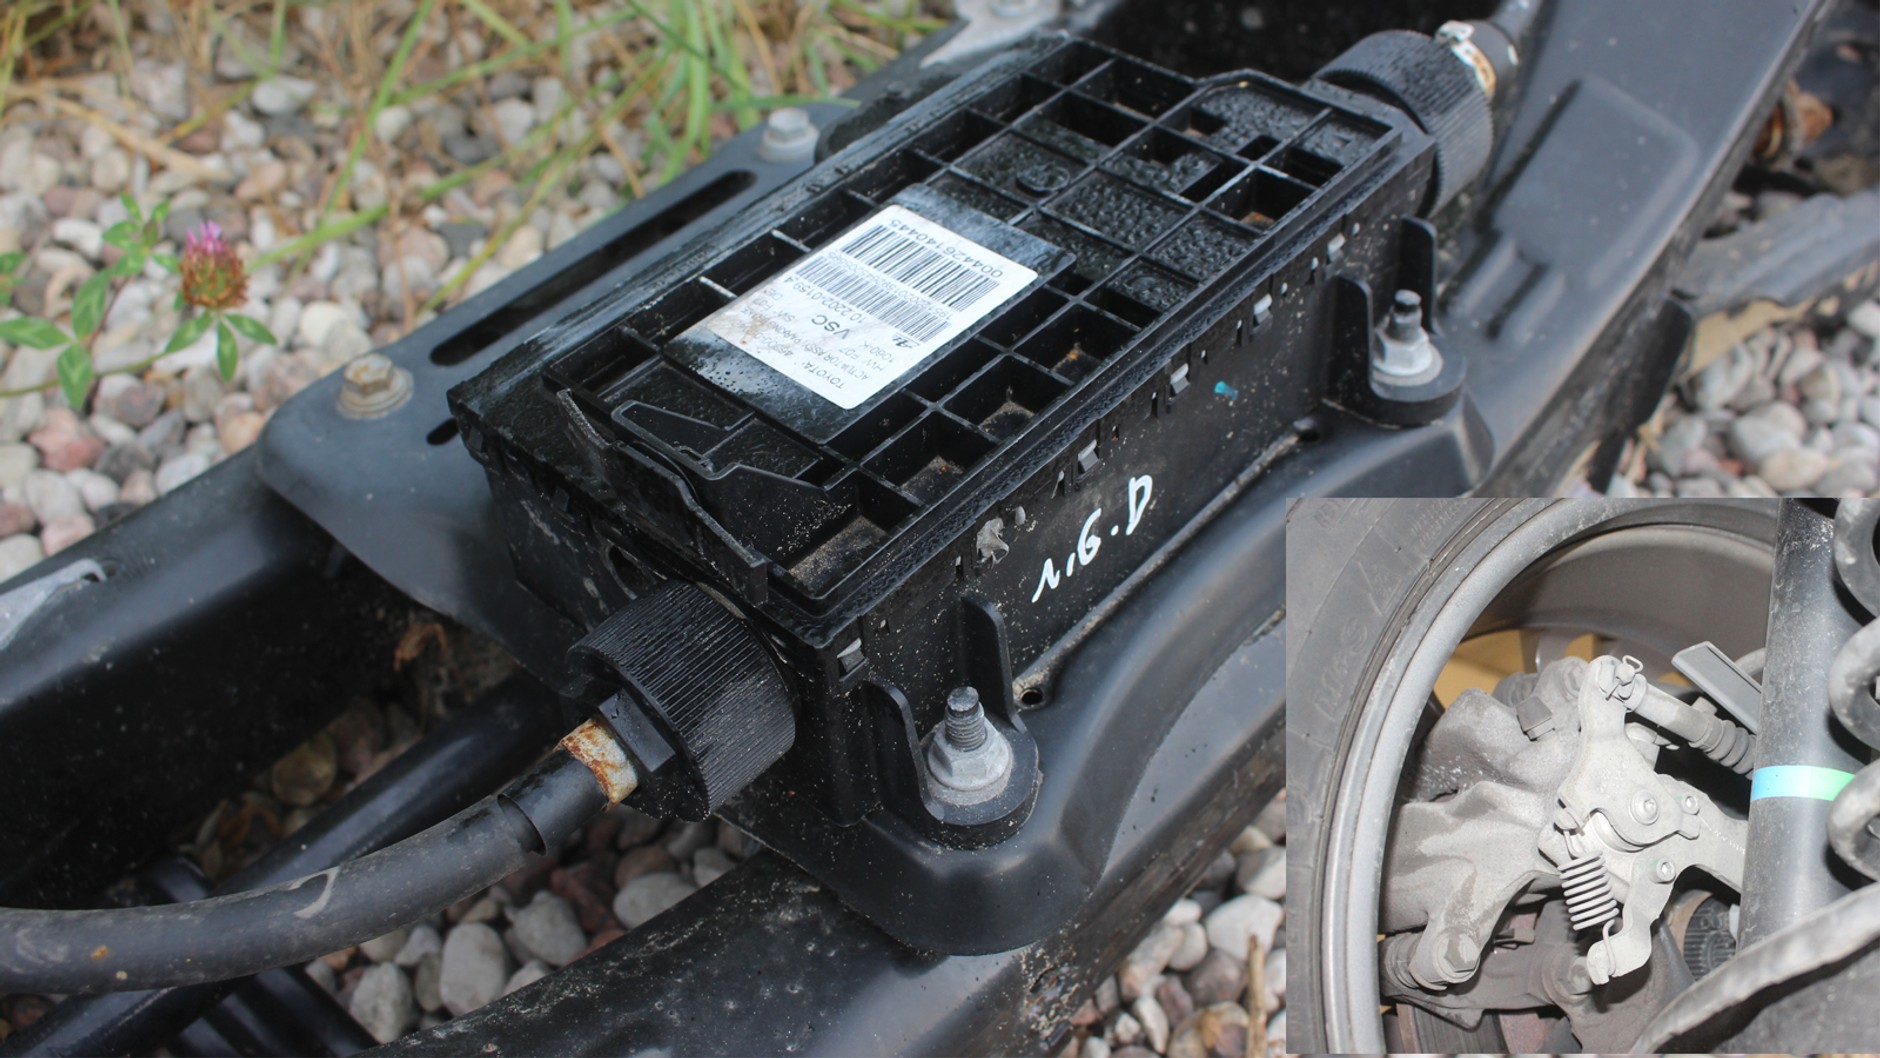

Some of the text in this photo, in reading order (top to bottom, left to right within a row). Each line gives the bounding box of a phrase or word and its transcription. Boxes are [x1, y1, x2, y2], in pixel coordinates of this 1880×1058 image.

[886, 219, 1004, 278] 004426140445
[763, 321, 805, 343] PARKING
[807, 313, 854, 339] VSC
[821, 353, 871, 380] ACTUATOR
